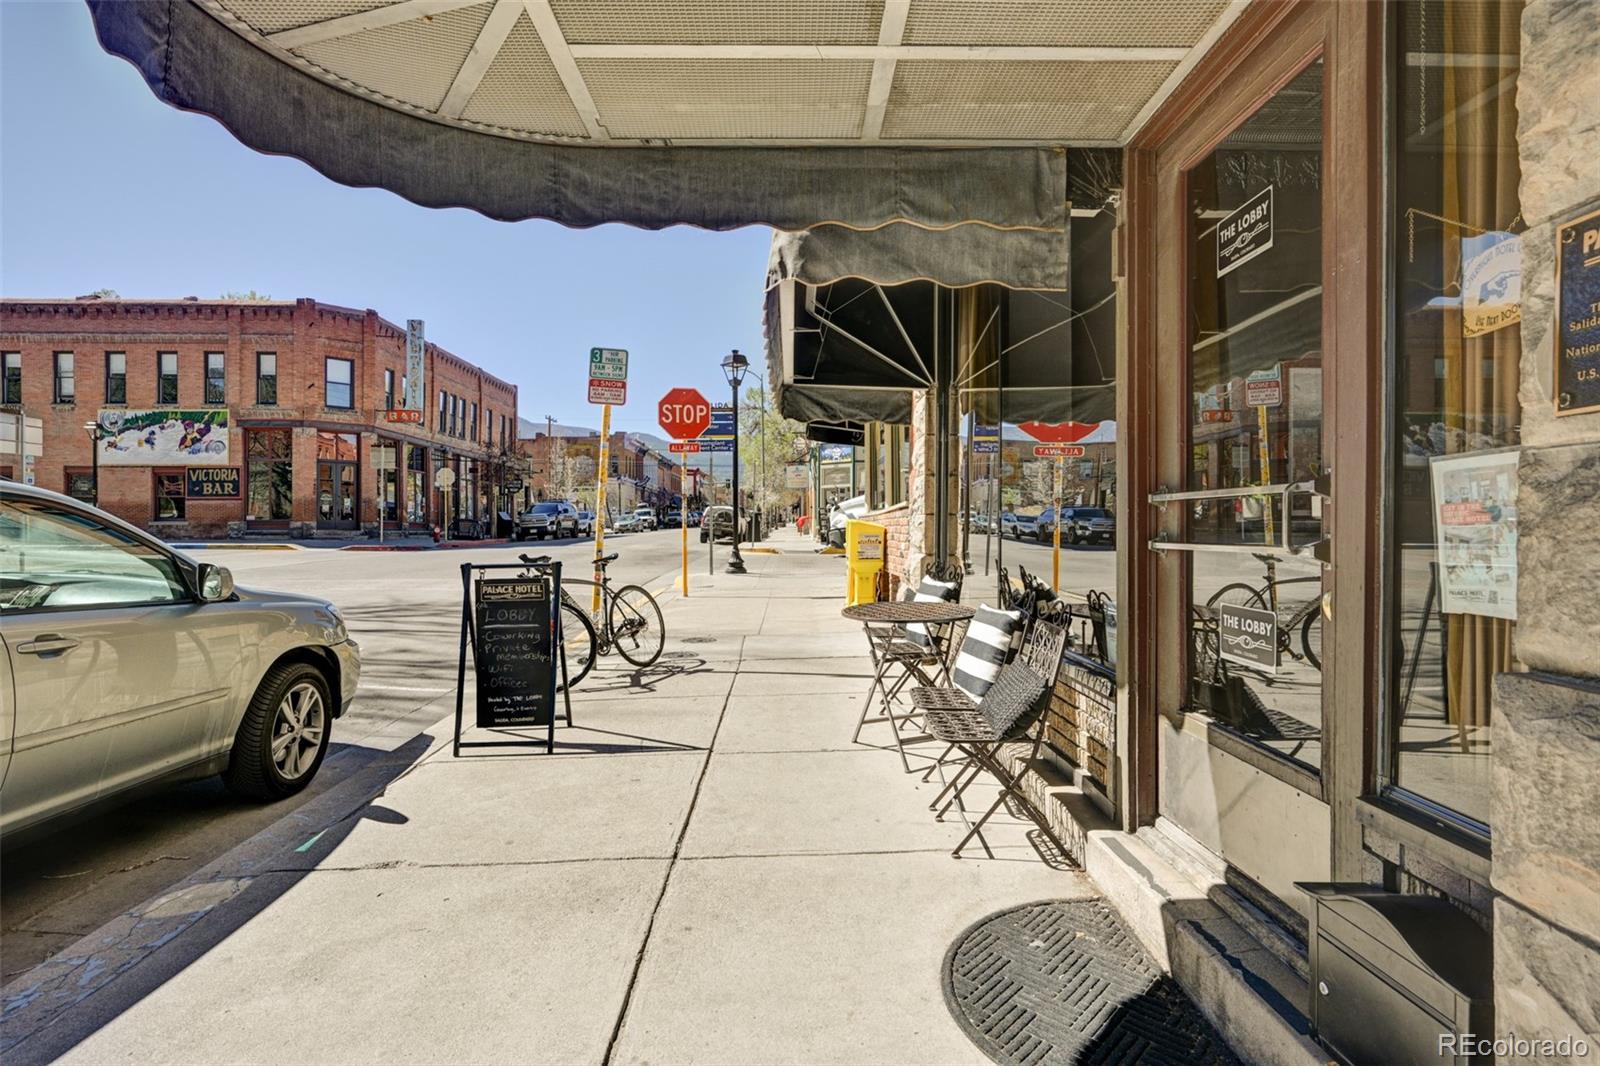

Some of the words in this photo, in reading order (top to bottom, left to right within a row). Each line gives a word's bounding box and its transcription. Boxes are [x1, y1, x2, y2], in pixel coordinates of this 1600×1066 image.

[1220, 223, 1236, 243] THE
[1238, 200, 1269, 232] LOBBY
[593, 350, 601, 362] 3
[600, 380, 623, 388] SNOW
[389, 411, 419, 420] BAR
[662, 404, 707, 424] STOP
[189, 469, 239, 481] VICTORIA
[202, 482, 237, 495] BAR
[482, 585, 514, 594] PALACE
[515, 584, 543, 593] HOTEL
[485, 608, 536, 622] LOBBY
[1223, 613, 1239, 629] THE
[1241, 618, 1272, 637] LOBBY
